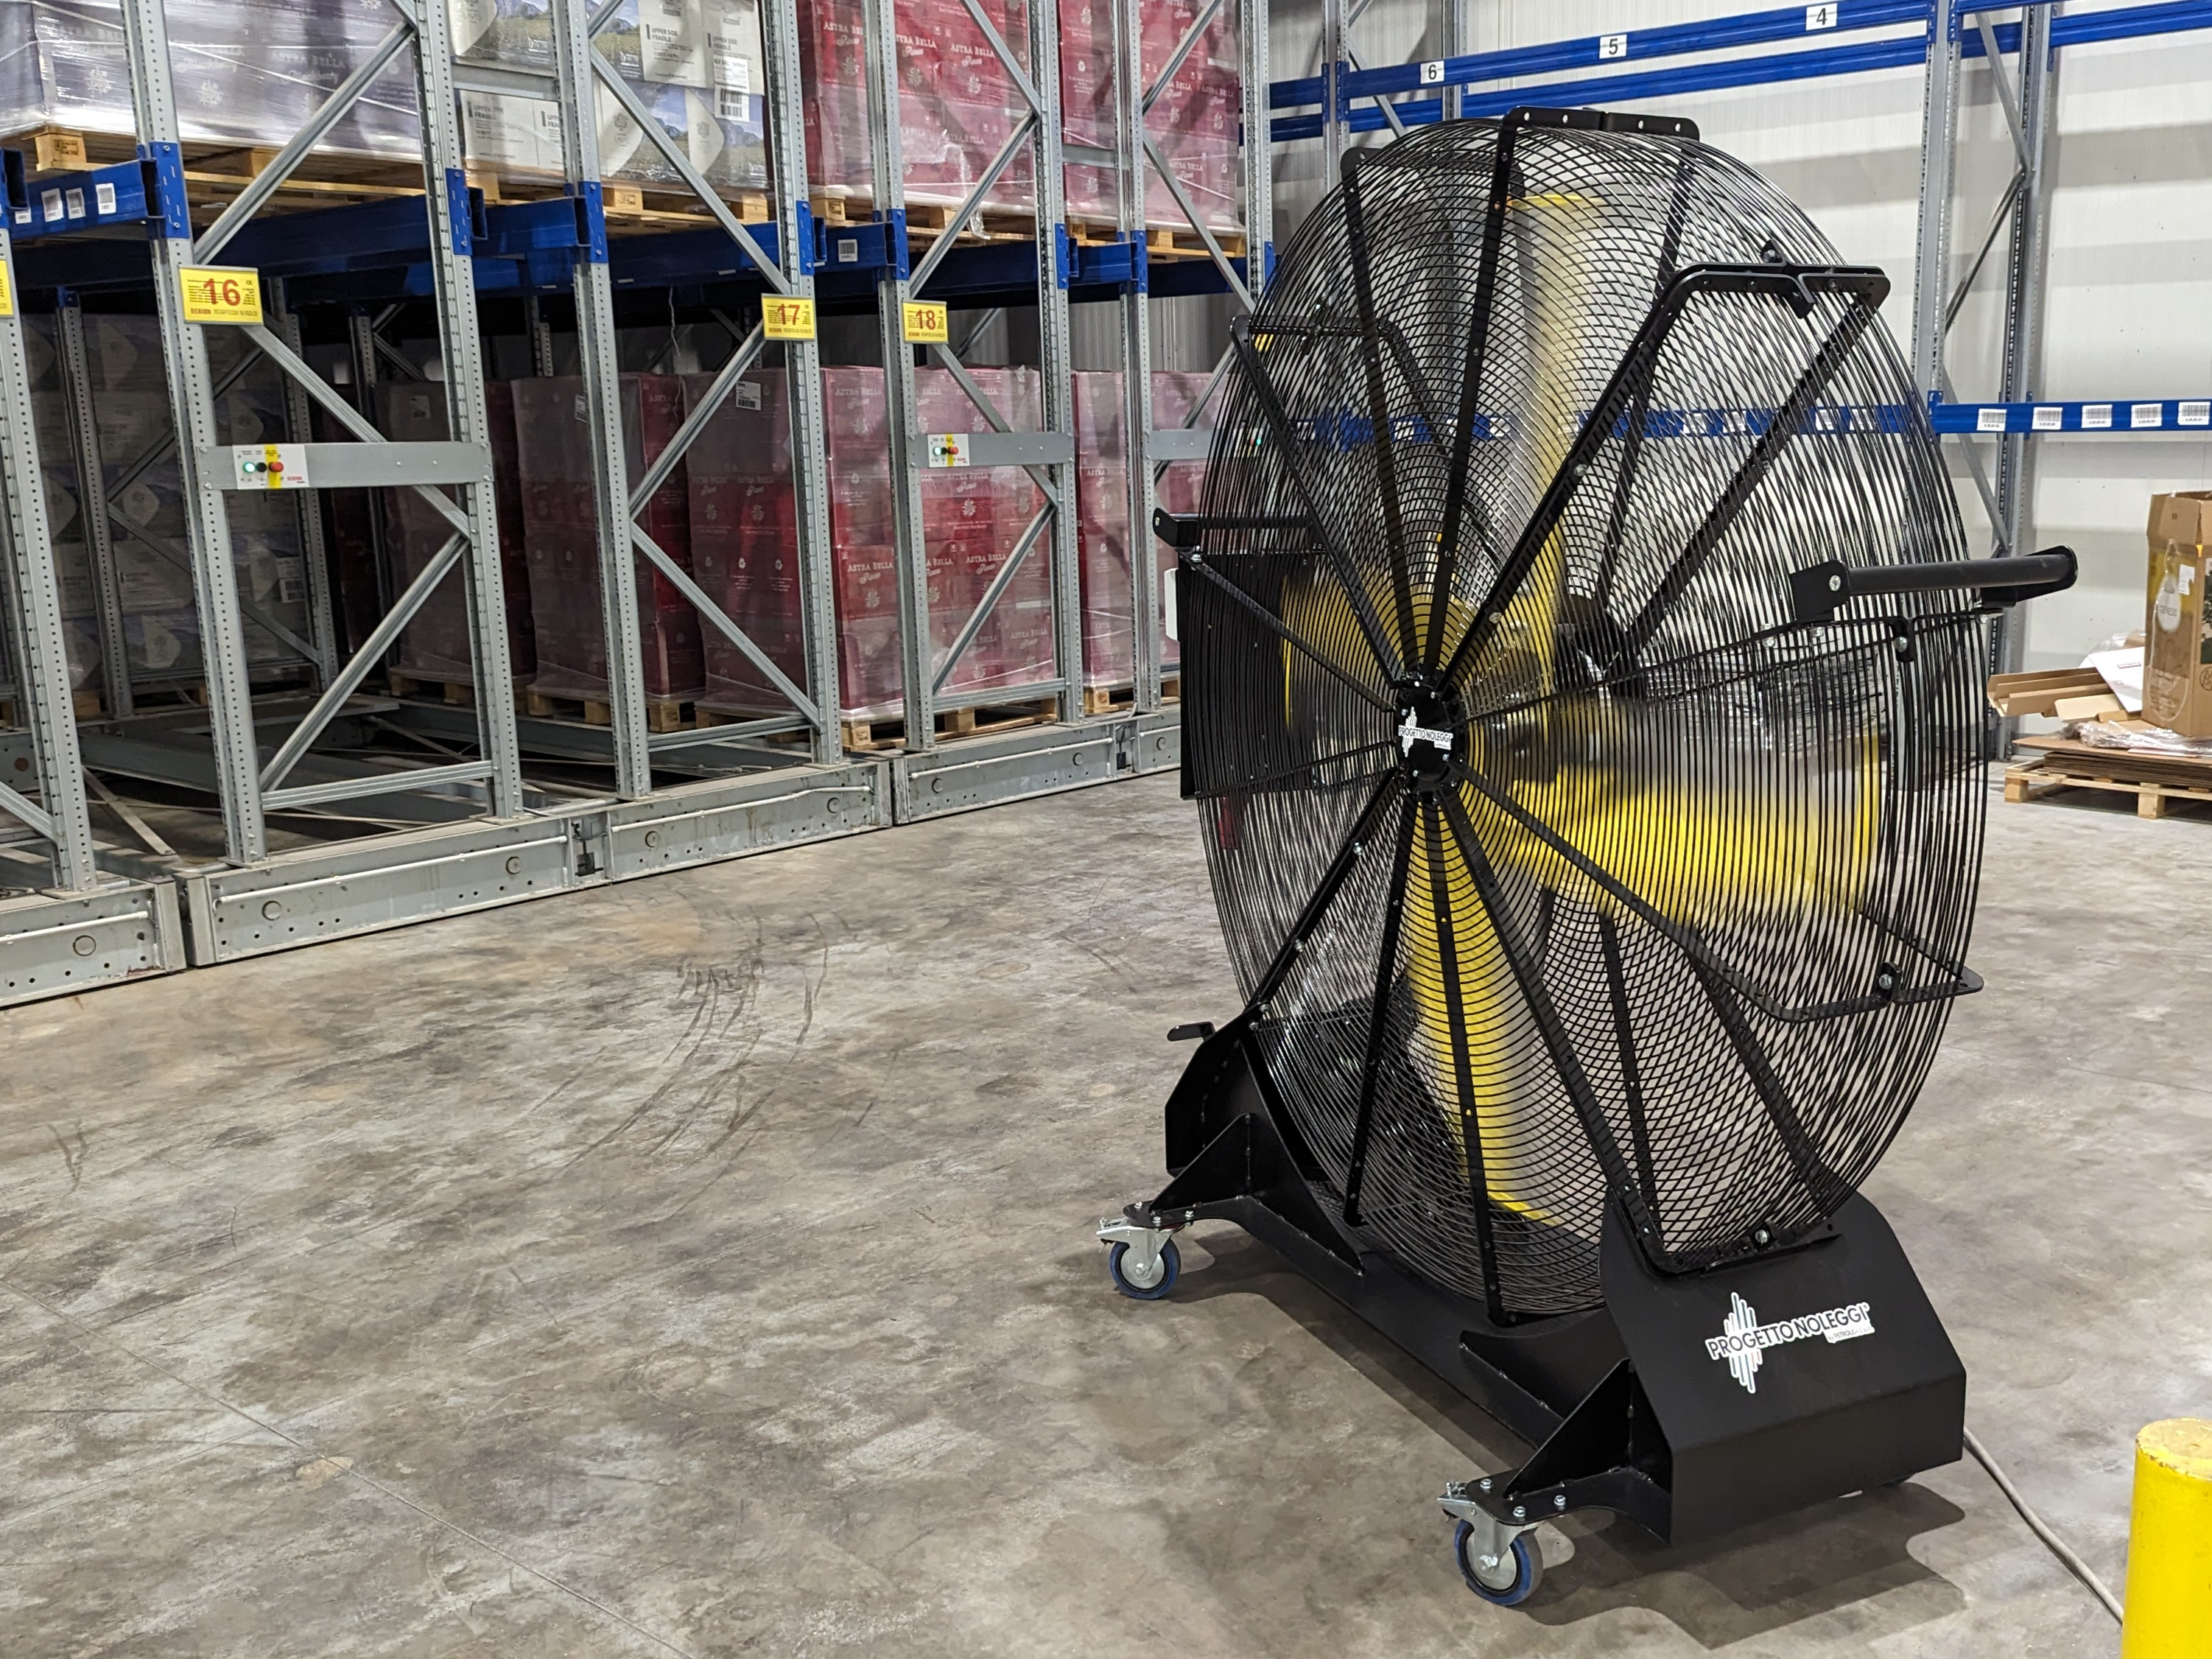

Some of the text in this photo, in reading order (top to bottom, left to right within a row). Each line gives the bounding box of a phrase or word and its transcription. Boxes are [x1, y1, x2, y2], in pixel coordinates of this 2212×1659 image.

[1816, 9, 1827, 26] 4
[824, 21, 849, 32] ASTRA
[915, 37, 936, 48] BELLA
[950, 43, 973, 55] ASTRA
[1608, 38, 1619, 55] 5
[1428, 65, 1437, 80] 6
[203, 278, 241, 306] 16
[777, 303, 800, 326] 17
[916, 309, 936, 330] 18
[848, 561, 894, 572] ASTRA BELLA
